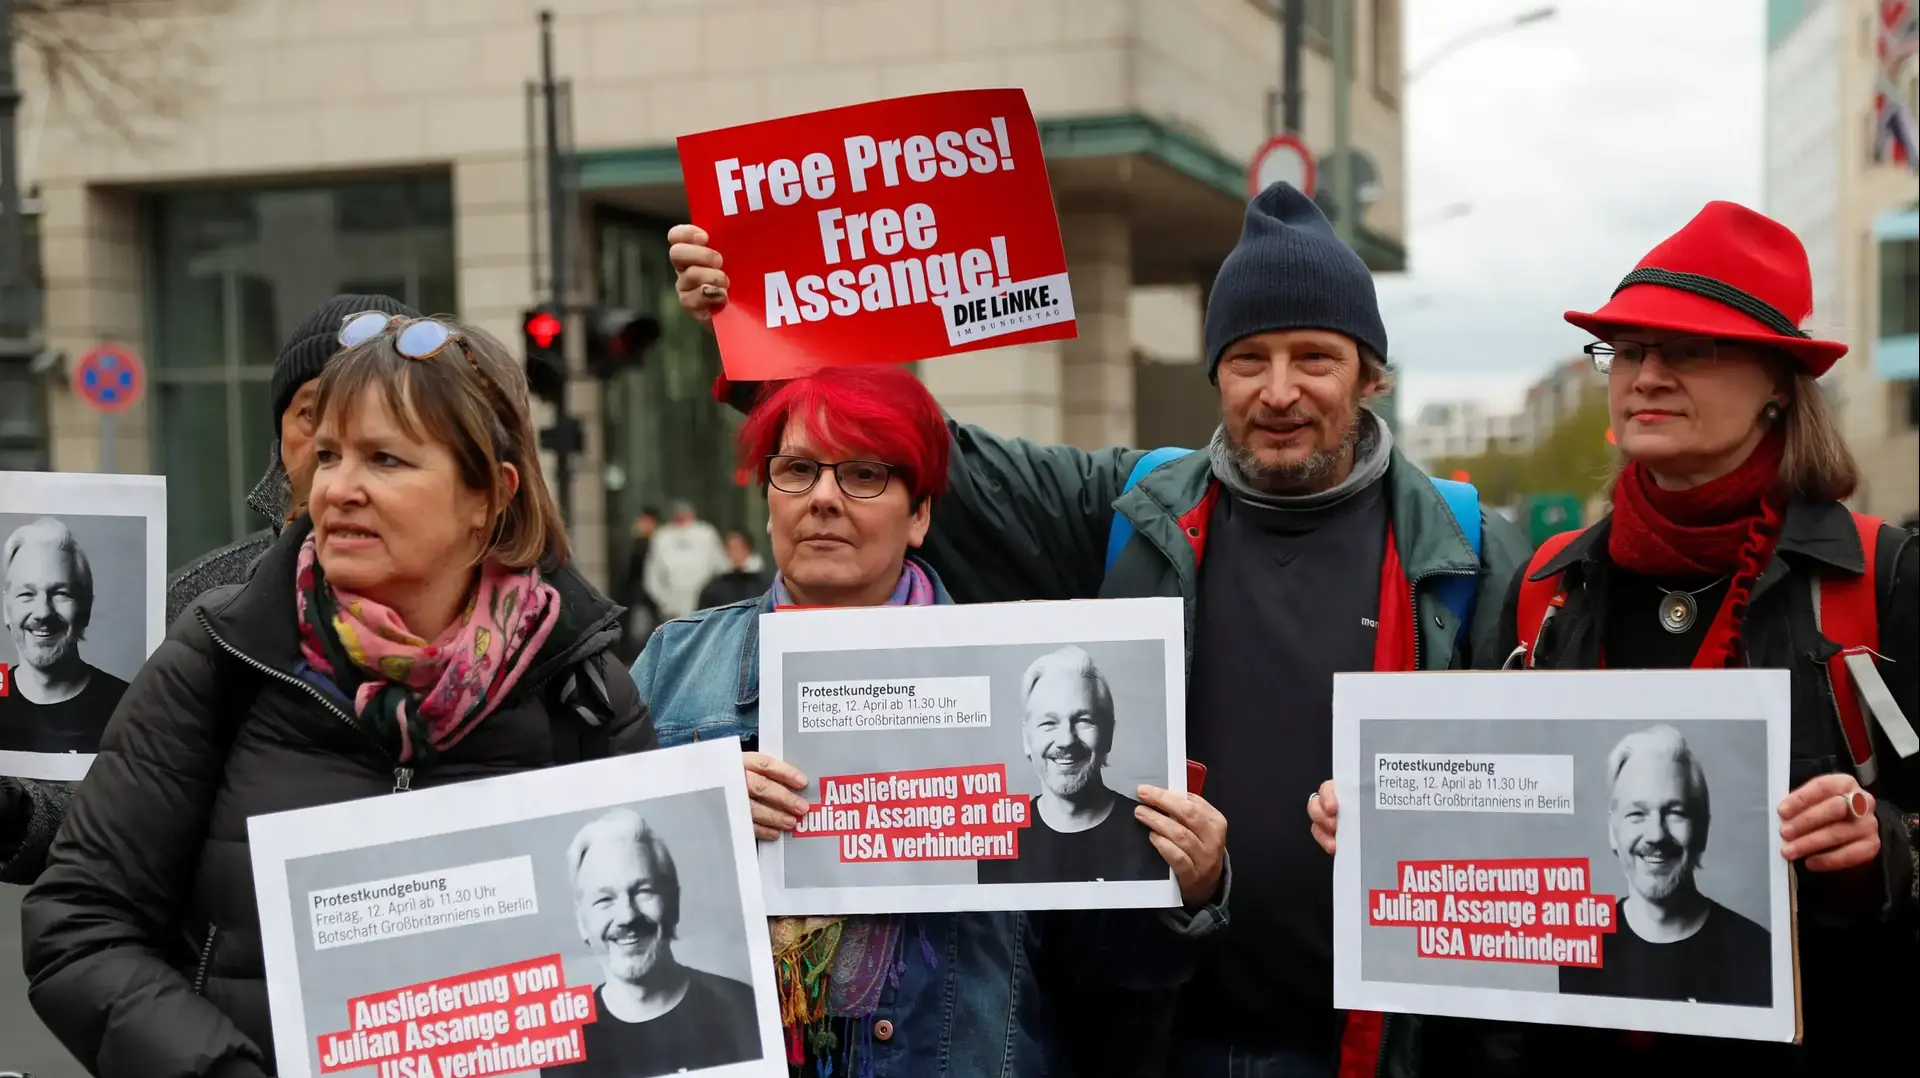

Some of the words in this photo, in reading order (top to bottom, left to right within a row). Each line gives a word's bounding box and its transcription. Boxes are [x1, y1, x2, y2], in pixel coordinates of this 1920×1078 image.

[715, 153, 836, 216] Free
[844, 117, 1015, 193] Press!
[817, 203, 937, 265] Free
[764, 236, 1012, 329] Assange!
[953, 298, 988, 327] DIE
[957, 328, 972, 337] IM
[980, 309, 1061, 332] BUNDESTAG
[802, 684, 916, 697] Protestkundgebung
[802, 700, 842, 715] Freitag,
[846, 700, 860, 711] 12.
[863, 698, 888, 712] April
[890, 698, 903, 710] ab
[908, 697, 935, 709] 11.30
[938, 697, 957, 708] Uhr
[802, 716, 853, 728] Botschaft
[855, 713, 941, 727] Großbritanniens
[944, 713, 953, 724] in
[957, 711, 987, 724] Berlin
[1379, 758, 1495, 775] Protestkundgebung
[825, 776, 957, 805] Auslieferung
[961, 772, 1001, 795] von
[1379, 775, 1419, 792] Freitag,
[1424, 776, 1438, 789] 12.
[1441, 776, 1466, 792] April
[1468, 778, 1482, 790] ab
[1488, 778, 1516, 791] 11.30
[1518, 778, 1539, 790] Uhr
[865, 804, 955, 829] Assange
[961, 802, 988, 825] an
[992, 799, 1025, 823] die
[1379, 792, 1431, 807] Botschaft
[1433, 793, 1522, 808] Großbritanniens
[1524, 795, 1535, 808] in
[1537, 795, 1571, 809] Berlin
[843, 833, 888, 859] USA
[892, 831, 1013, 858] verhindern!
[314, 878, 447, 908] Protestkundgebung
[1402, 864, 1539, 895] Auslieferung
[1543, 866, 1585, 892] von
[316, 909, 363, 927] Freitag,
[367, 904, 386, 921] 12.
[388, 897, 416, 918] April
[419, 896, 436, 911] ab
[439, 891, 472, 908] 11.30
[474, 885, 498, 901] Uhr
[318, 924, 378, 944] Botschaft
[381, 907, 481, 932] Großbritanniens
[483, 904, 496, 919] in
[498, 898, 533, 914] Berlin
[1373, 893, 1438, 922] Julian
[1443, 894, 1537, 928] Assange
[1541, 900, 1571, 926] an
[1575, 897, 1611, 927] die
[1420, 927, 1465, 955] USA
[1469, 930, 1598, 964] verhindern!
[355, 975, 508, 1031] Auslieferung
[512, 963, 560, 996] von
[323, 1031, 400, 1067] Julian
[405, 1010, 510, 1052] Assange
[515, 1001, 548, 1031] an
[551, 990, 590, 1024] die
[381, 1054, 436, 1078] USA
[438, 1029, 580, 1078] verhindern!
